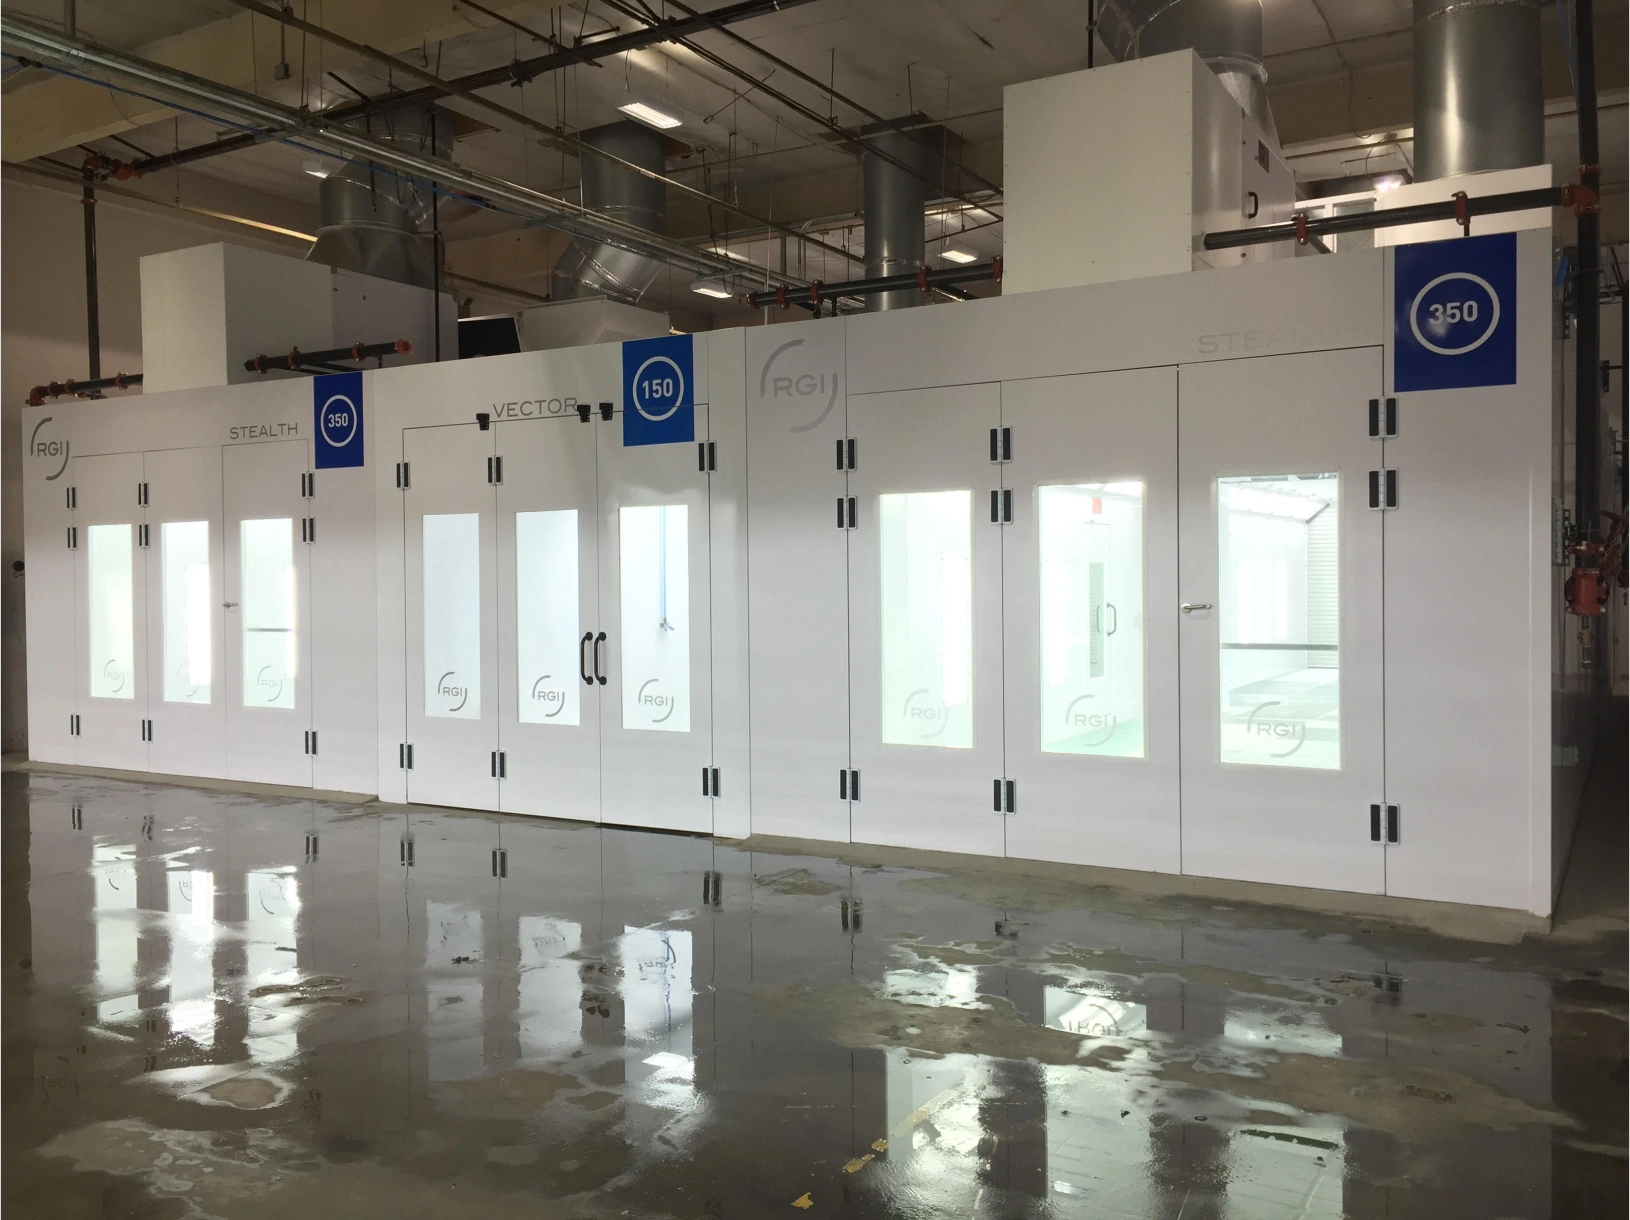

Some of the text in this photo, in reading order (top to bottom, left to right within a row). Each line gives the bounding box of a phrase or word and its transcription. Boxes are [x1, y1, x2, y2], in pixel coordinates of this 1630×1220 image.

[1428, 300, 1478, 325] 350
[1198, 324, 1360, 354] STEAH
[642, 378, 673, 399] 150
[773, 373, 825, 398] RGI
[493, 397, 578, 418] VECTOR
[328, 413, 348, 427] 350
[230, 423, 298, 440] STEALTH
[37, 441, 63, 457] RGI
[442, 686, 463, 697] RGI
[537, 690, 560, 702] RGI
[644, 695, 668, 707] RGI
[911, 707, 941, 721] RGI
[1074, 714, 1108, 728] RGI
[1257, 722, 1295, 737] RGI
